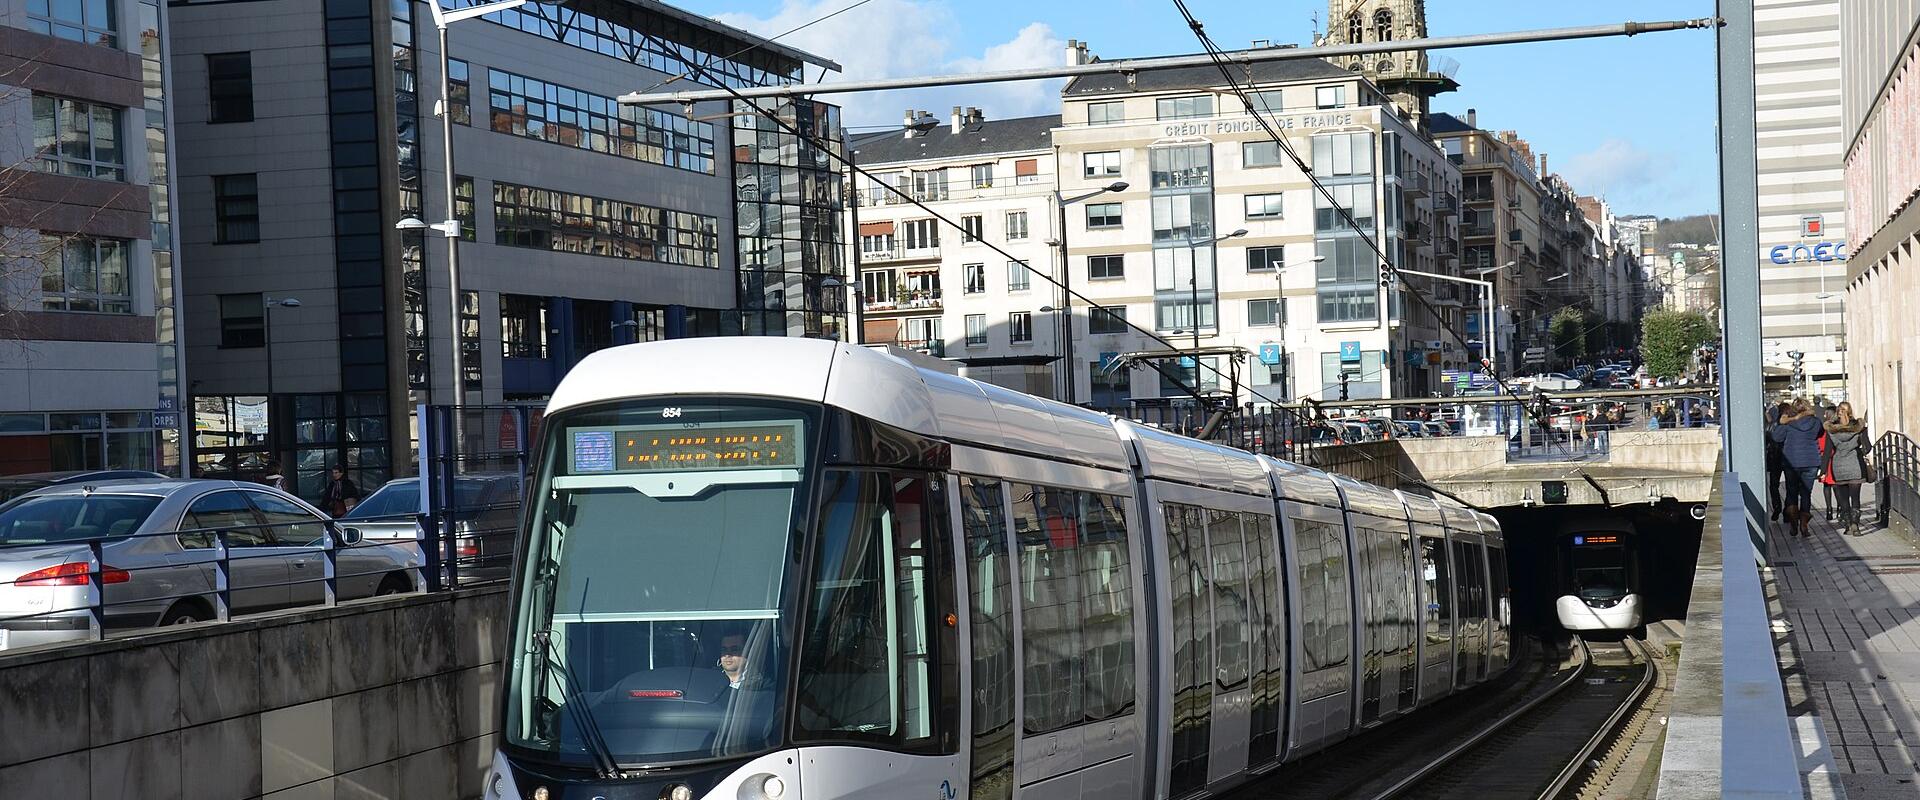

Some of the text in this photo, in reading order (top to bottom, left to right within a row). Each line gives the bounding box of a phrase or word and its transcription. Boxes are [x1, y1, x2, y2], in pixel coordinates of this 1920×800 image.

[1165, 123, 1208, 136] CRÉDIT
[1278, 118, 1294, 129] DE
[1304, 114, 1351, 127] FRANCE
[662, 407, 682, 418] 854
